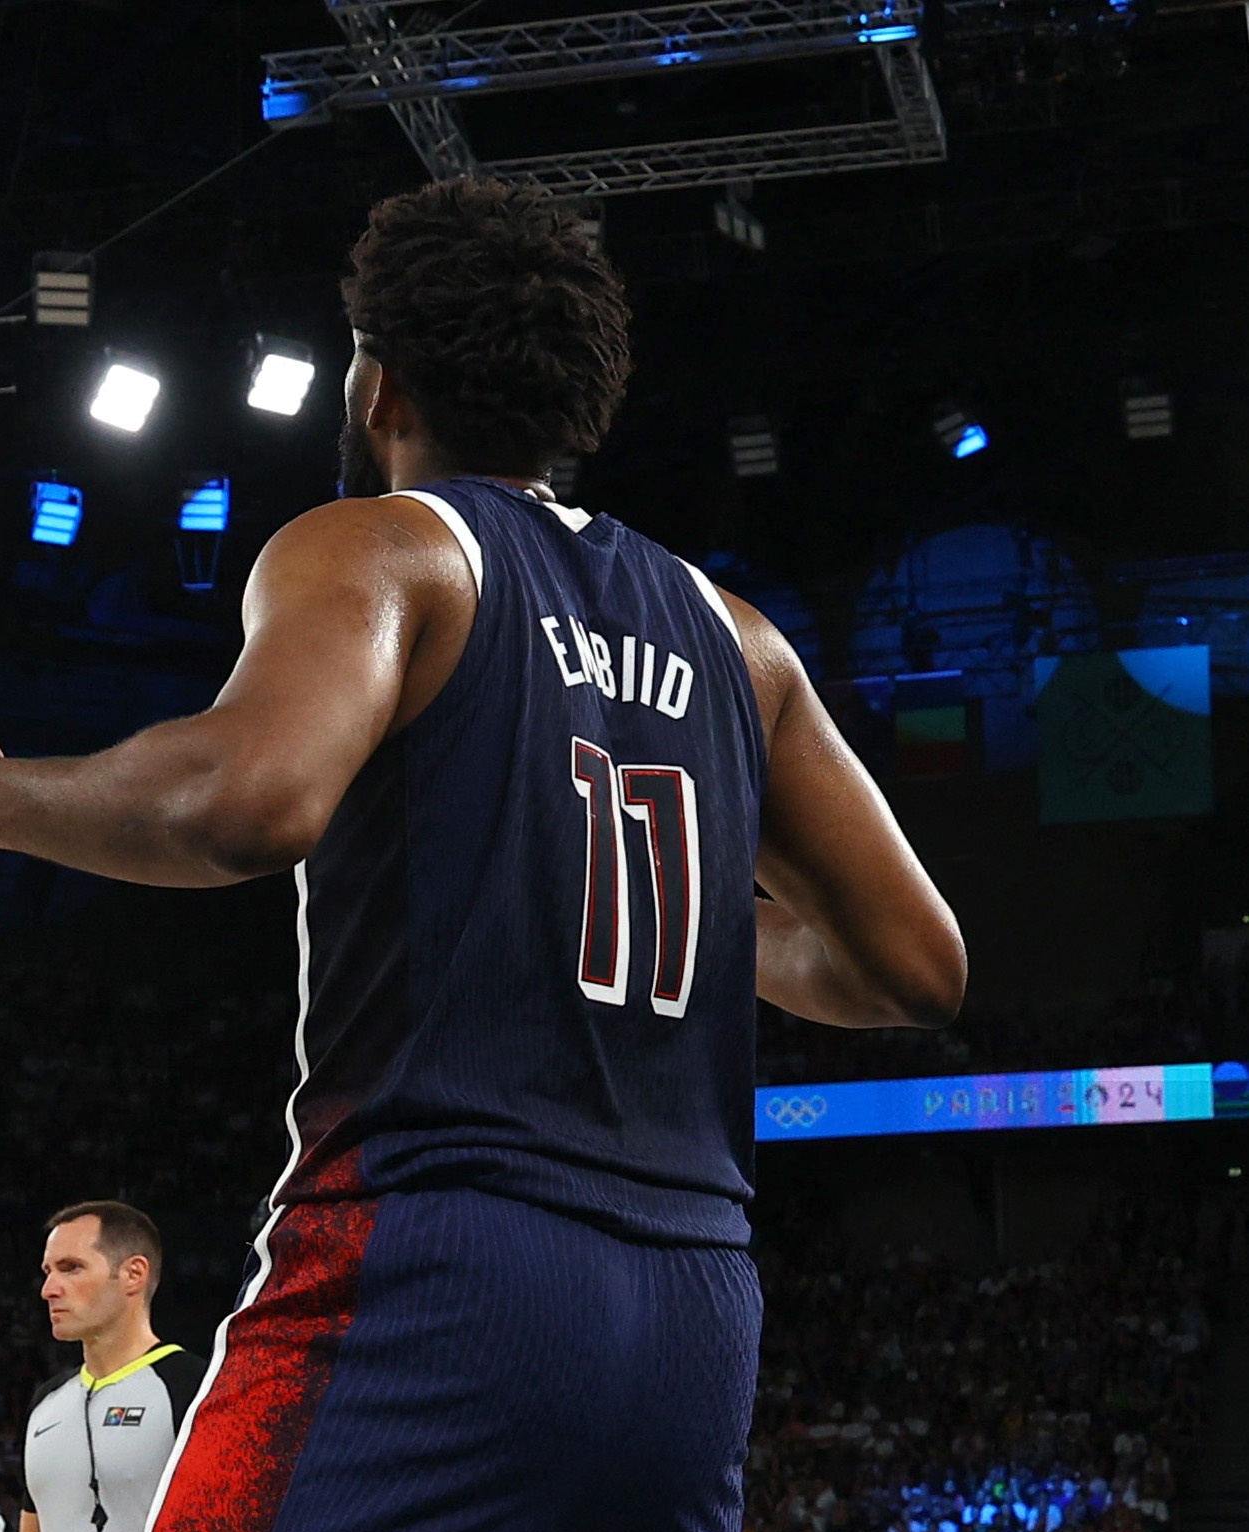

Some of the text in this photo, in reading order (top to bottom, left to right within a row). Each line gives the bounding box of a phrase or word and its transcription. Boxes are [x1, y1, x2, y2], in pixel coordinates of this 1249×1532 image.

[540, 614, 694, 719] EMBIID
[571, 736, 701, 1018] 11
[1057, 1080, 1163, 1113] 2024
